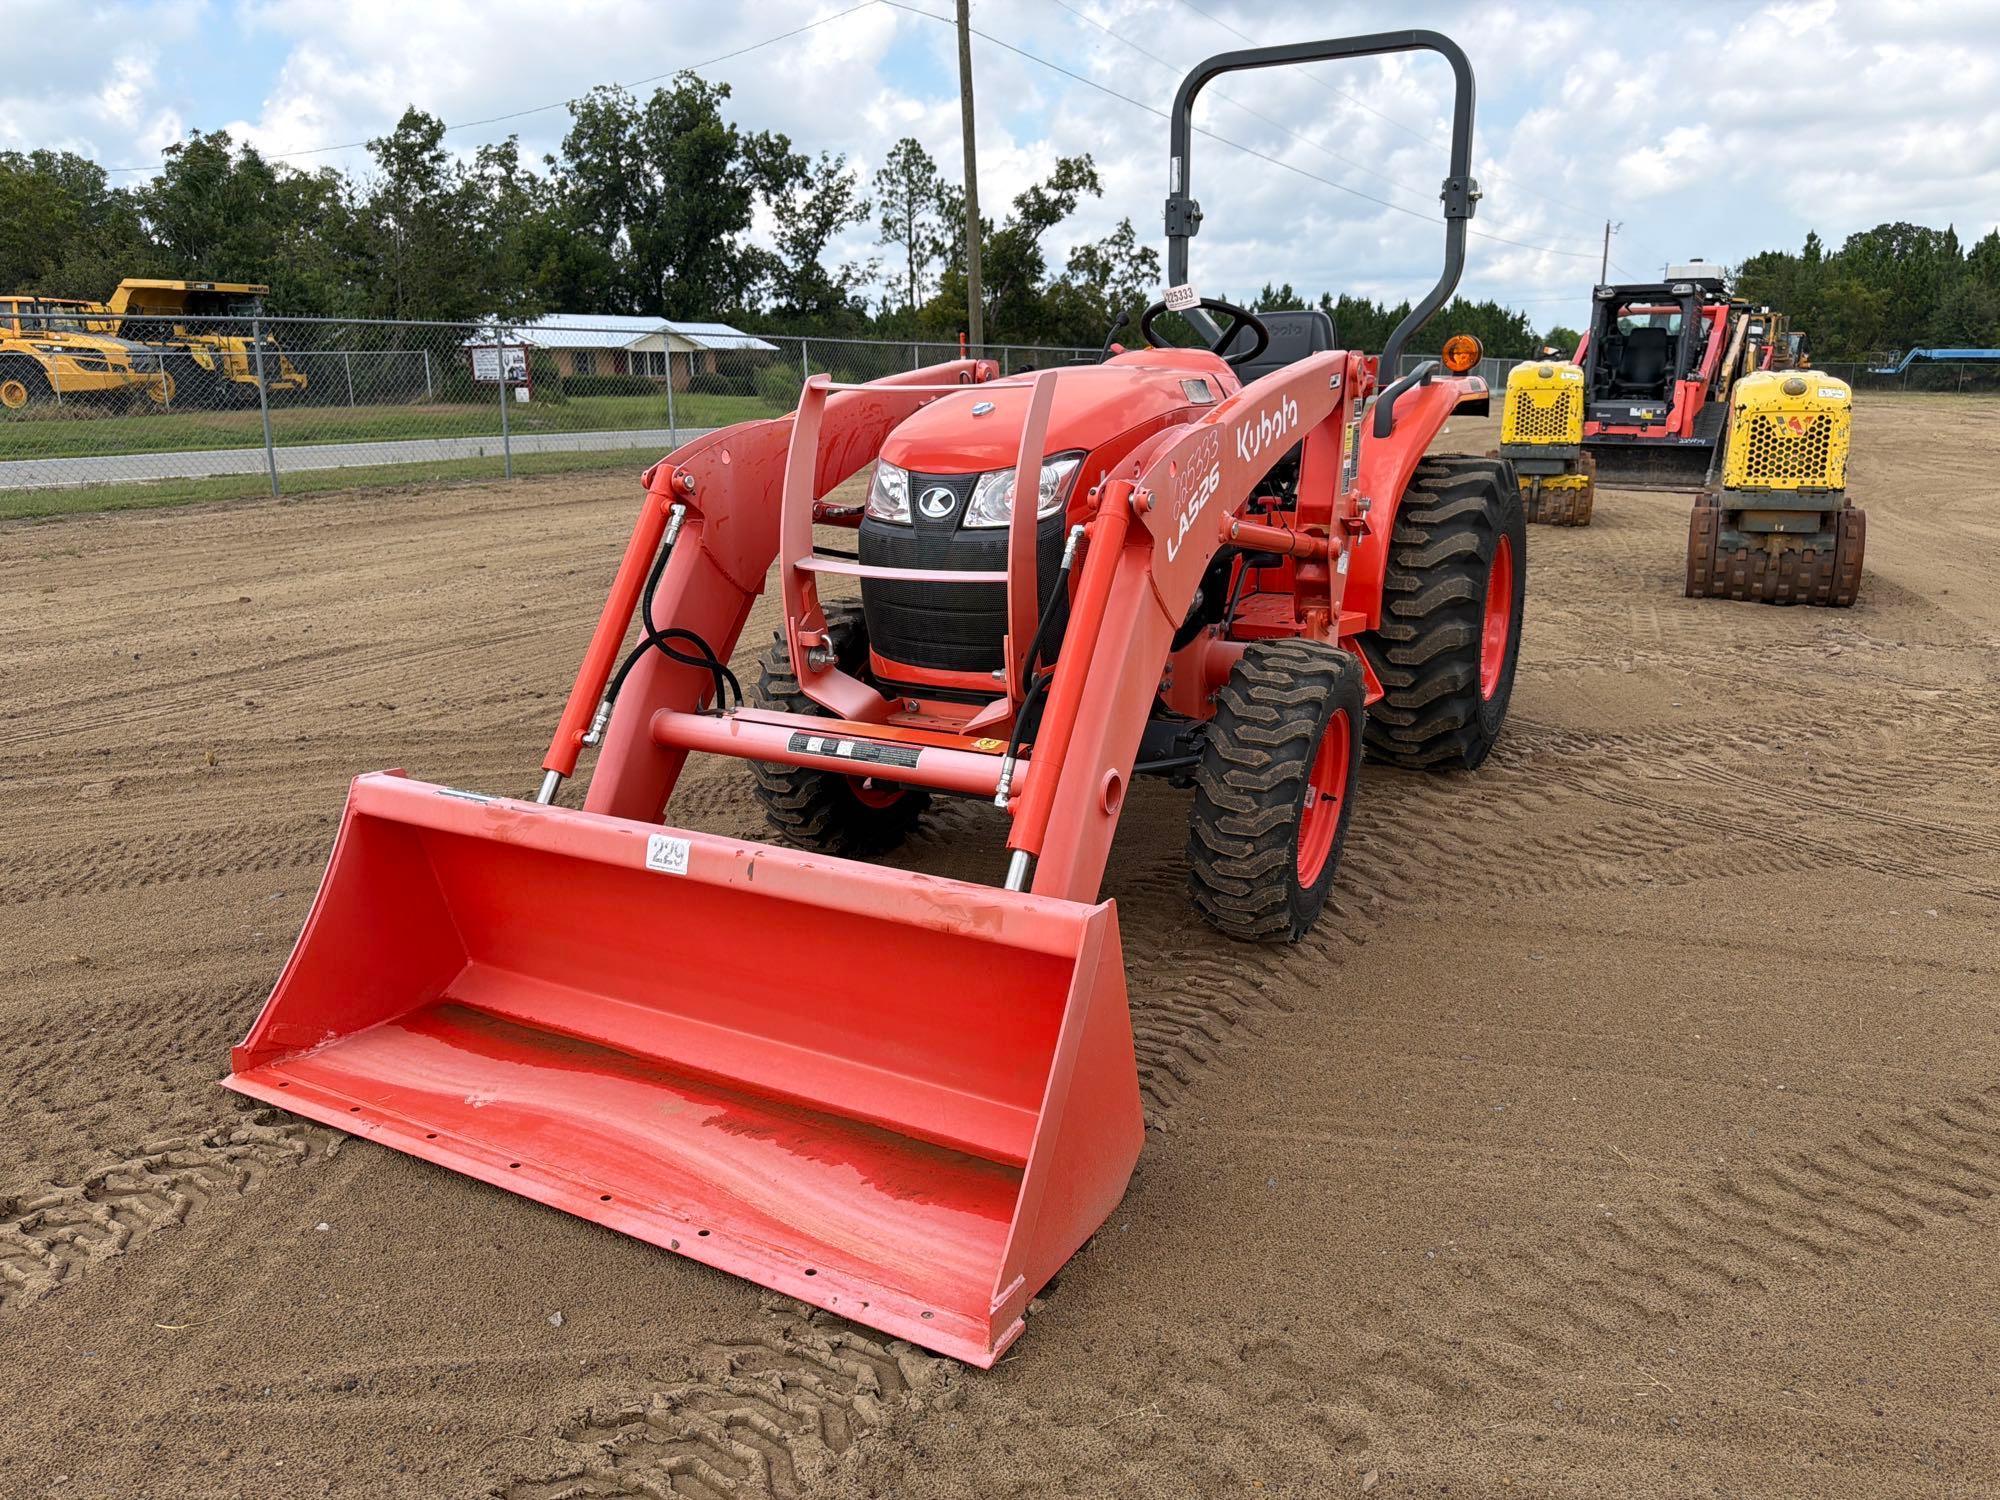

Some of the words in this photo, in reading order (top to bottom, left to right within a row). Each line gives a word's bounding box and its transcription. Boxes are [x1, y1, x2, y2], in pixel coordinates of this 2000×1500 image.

[1165, 287, 1194, 303] 225333
[1236, 394, 1298, 463] Kubota
[1167, 461, 1220, 562] LA526
[1173, 429, 1220, 521] 225333
